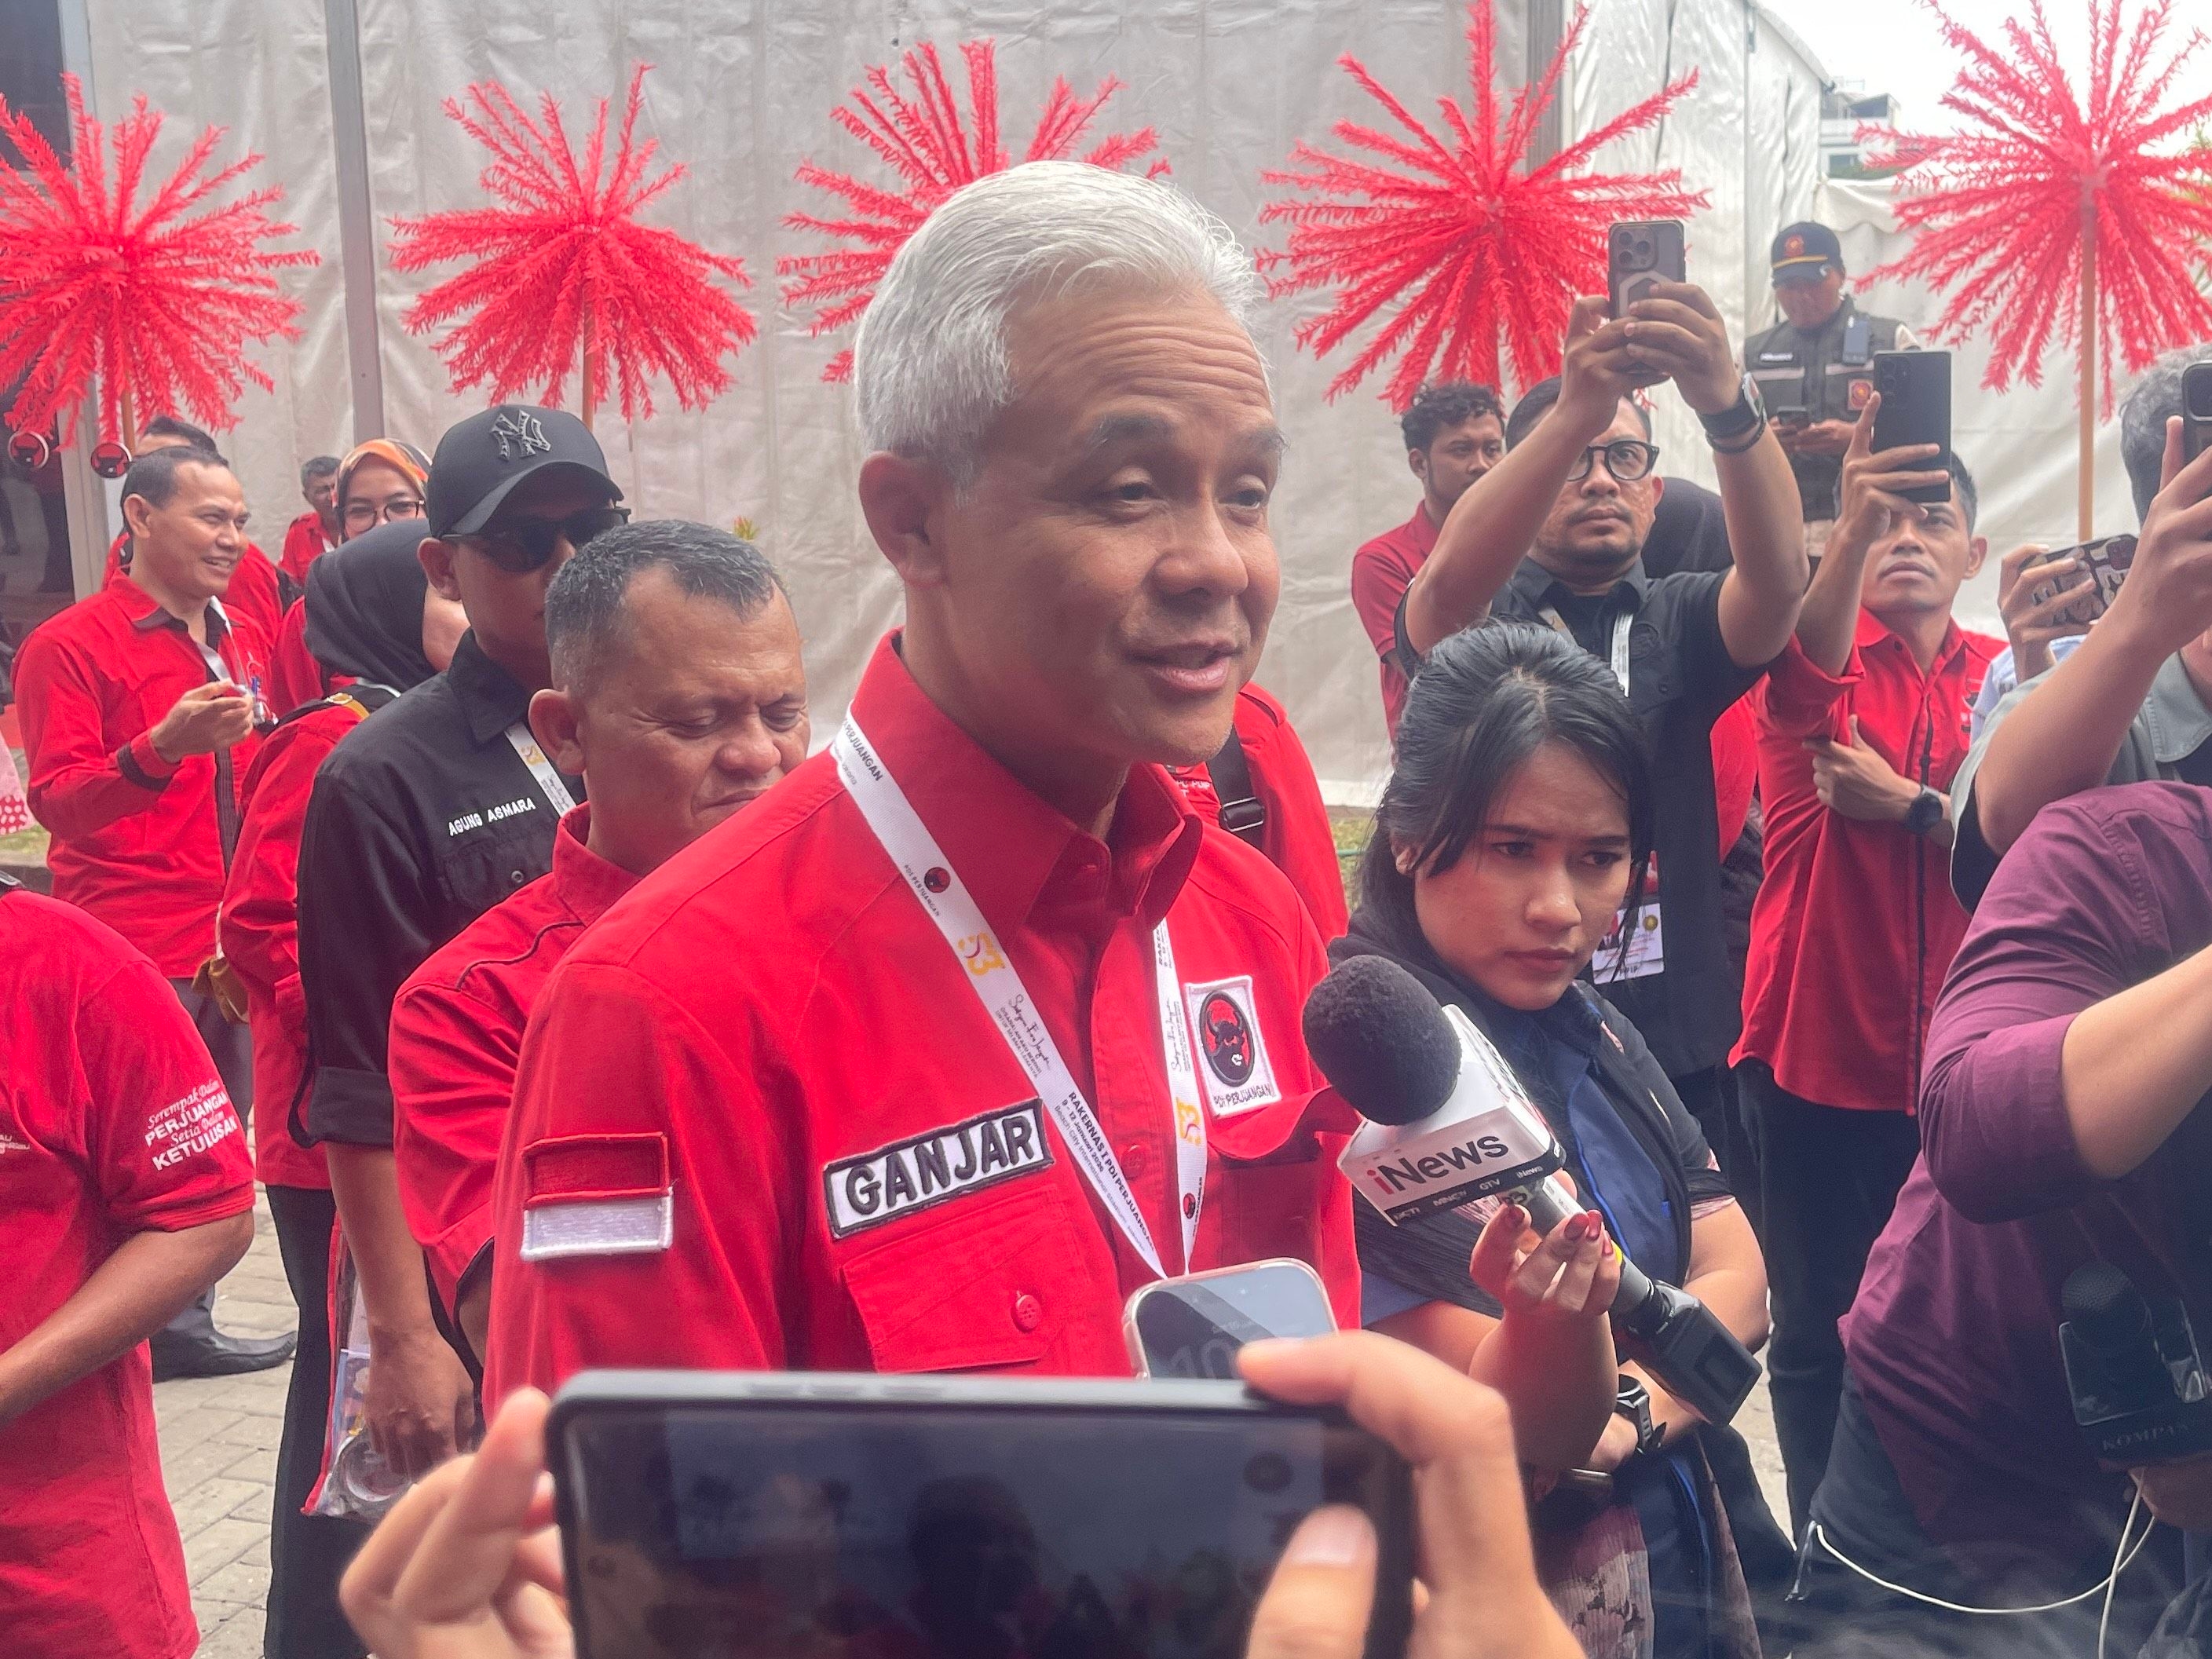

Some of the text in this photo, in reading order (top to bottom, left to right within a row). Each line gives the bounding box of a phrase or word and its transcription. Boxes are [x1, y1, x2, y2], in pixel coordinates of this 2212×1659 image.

[448, 797, 536, 837] AGUNG ASMARA
[170, 1124, 202, 1146] Setia
[1054, 1104, 1071, 1131] Beach
[1068, 1129, 1080, 1147] City
[1068, 1091, 1105, 1153] RAKERNAS
[1104, 1158, 1118, 1179] PDI
[1069, 1110, 1077, 1122] 12
[1073, 1120, 1094, 1153] Januari
[846, 1115, 1035, 1215] GANJAR
[1366, 1135, 1509, 1195] iNews
[1479, 1178, 1501, 1191] GTV
[1515, 1165, 1544, 1178] iNews
